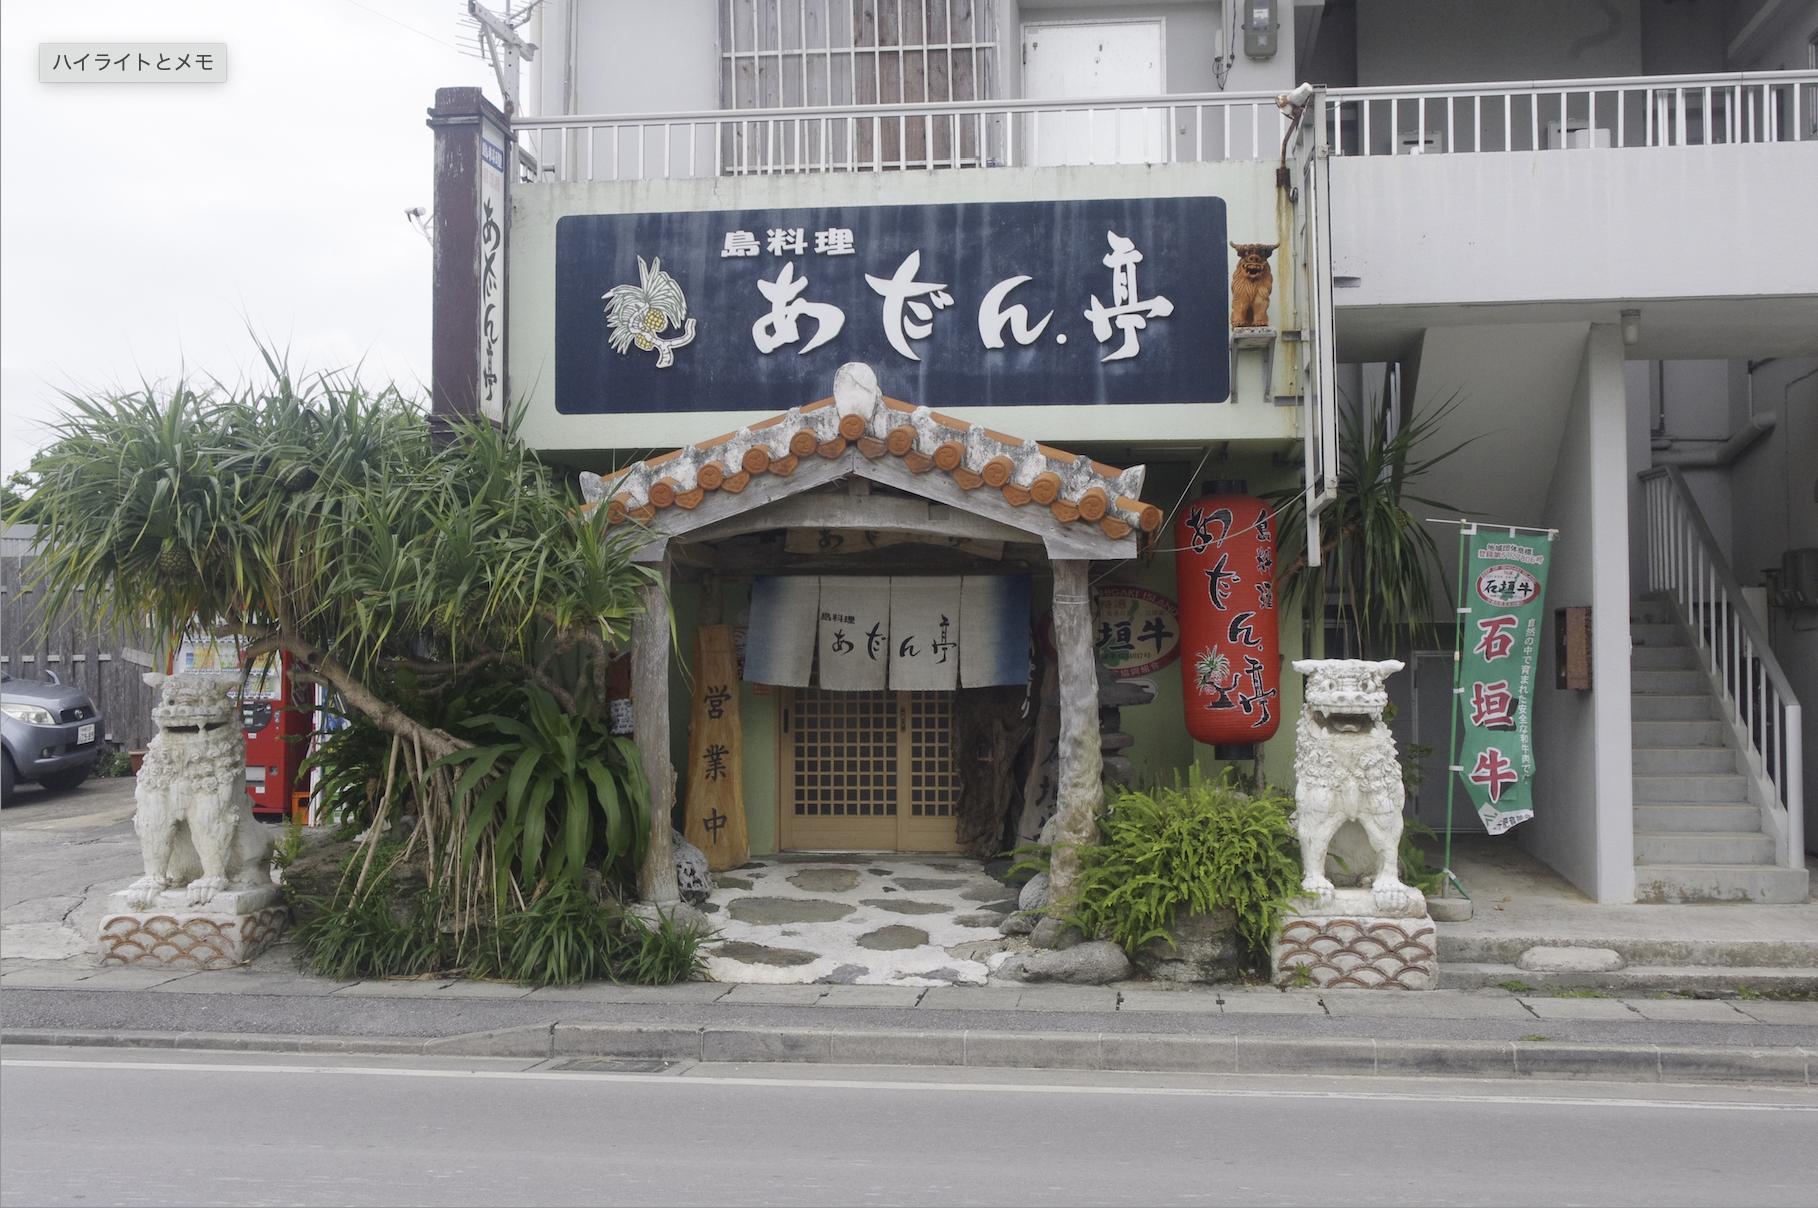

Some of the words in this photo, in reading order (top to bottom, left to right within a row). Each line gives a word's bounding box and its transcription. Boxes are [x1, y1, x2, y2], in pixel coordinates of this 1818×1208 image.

[721, 228, 856, 257] 島料理
[1254, 509, 1274, 609] 島料理
[1484, 579, 1533, 598] 石垣牛
[820, 612, 856, 625] 島料理
[831, 614, 957, 664] あだん亭
[1095, 617, 1174, 655] 垣牛
[1469, 615, 1518, 804] 石垣牛
[703, 685, 732, 844] 営業中
